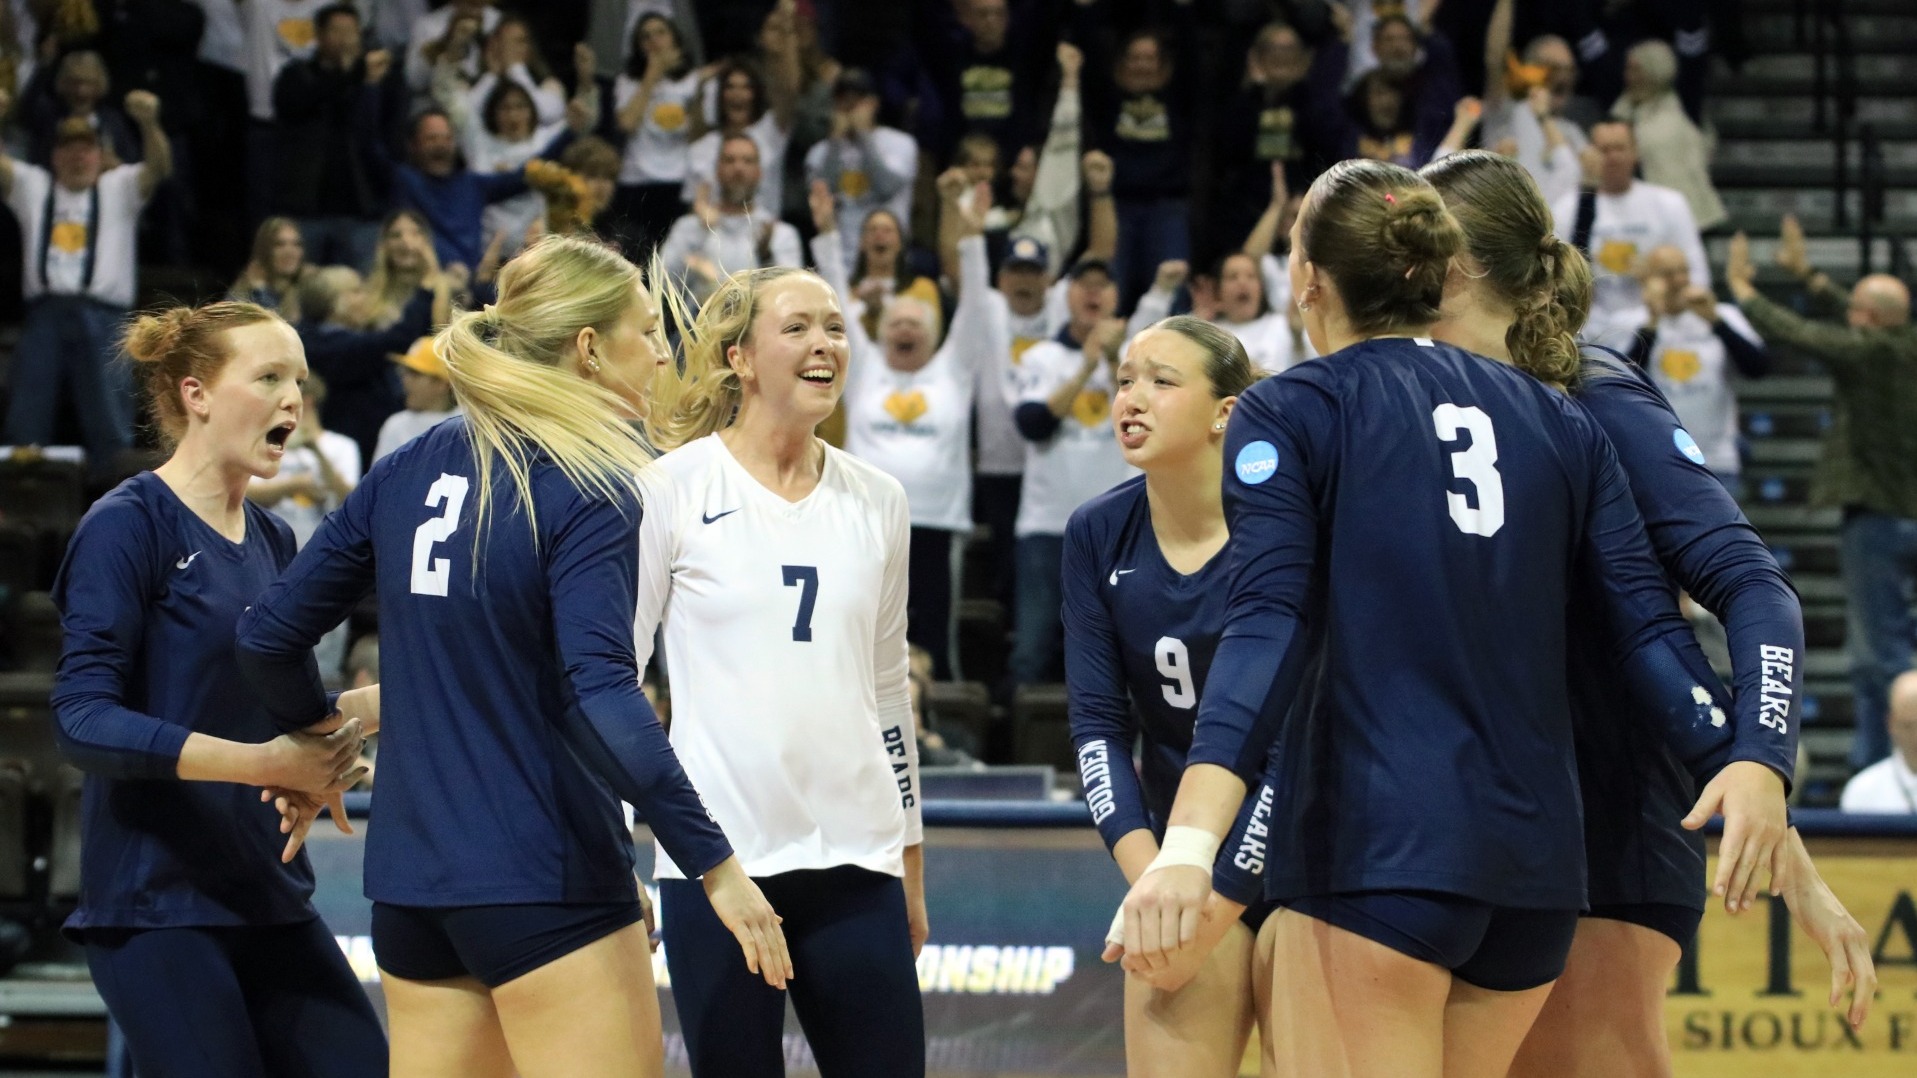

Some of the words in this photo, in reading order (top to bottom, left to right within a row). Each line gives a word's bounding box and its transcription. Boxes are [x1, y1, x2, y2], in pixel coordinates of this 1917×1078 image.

[1241, 458, 1276, 475] NCAA
[1432, 403, 1504, 537] 3
[411, 472, 469, 597] 2
[781, 565, 819, 642] 7
[1155, 636, 1196, 709] 9
[1759, 644, 1793, 735] BEARS
[1078, 739, 1116, 825] GOLDEN
[915, 944, 1075, 994] ONSHIP
[1683, 1008, 1864, 1051] SIOUX
